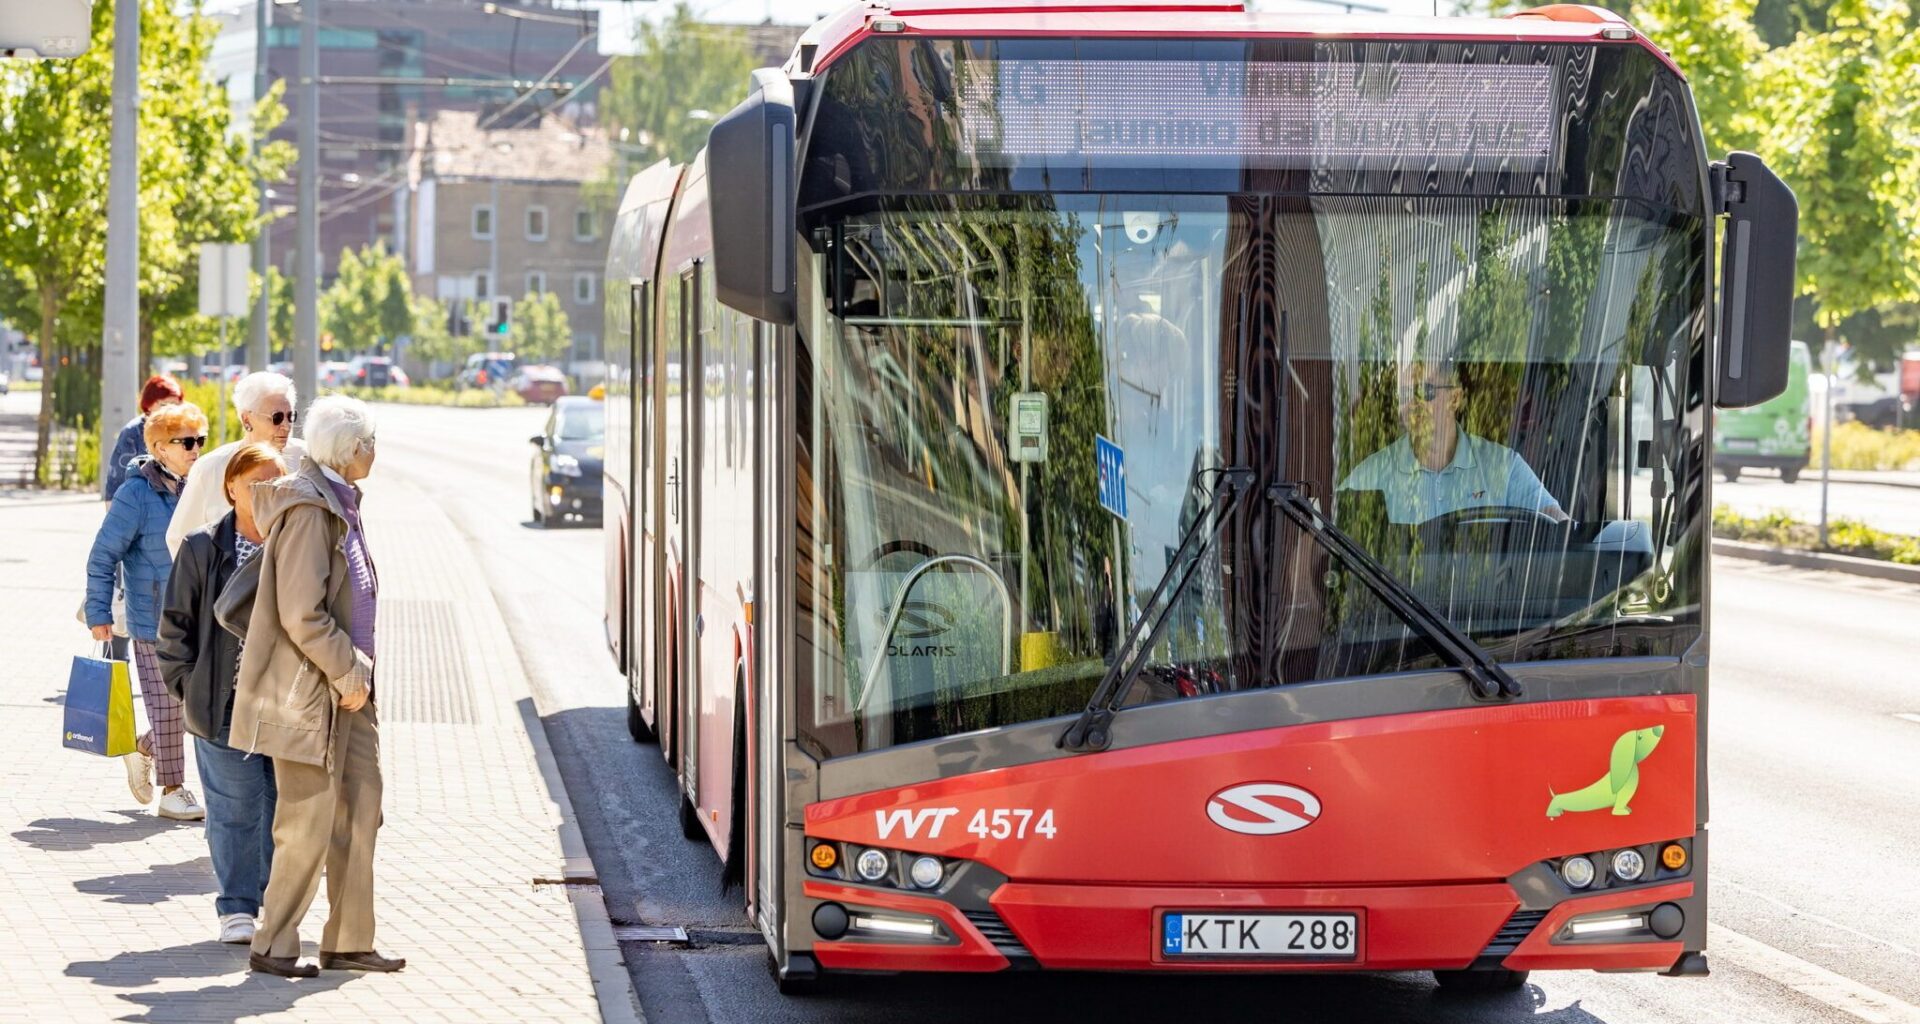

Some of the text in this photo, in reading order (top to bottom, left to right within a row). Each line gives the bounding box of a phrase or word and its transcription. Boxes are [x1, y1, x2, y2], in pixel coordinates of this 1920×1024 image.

[1071, 109, 1532, 156] jaunimo darbuotojus
[874, 645, 957, 657] OLARIS
[967, 808, 1057, 839] 4574
[1166, 938, 1181, 947] LT
[1186, 919, 1349, 950] KTK 288
